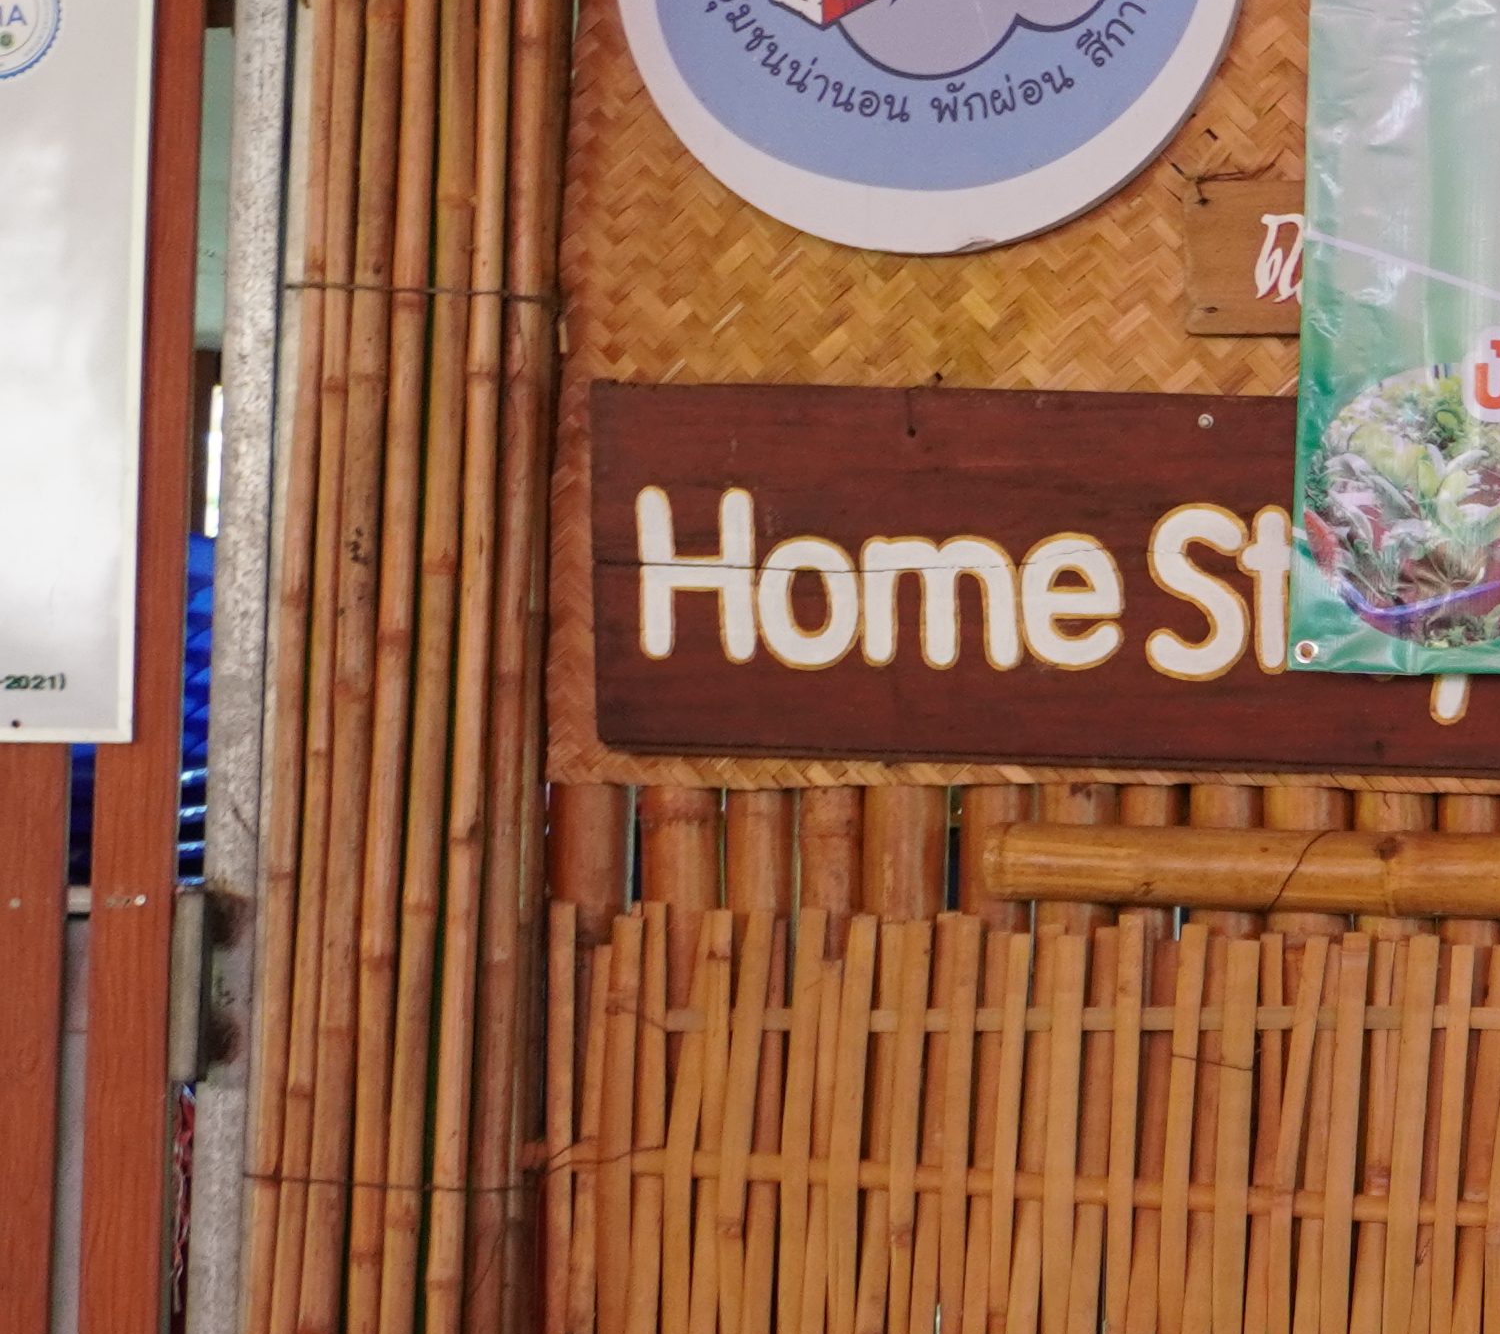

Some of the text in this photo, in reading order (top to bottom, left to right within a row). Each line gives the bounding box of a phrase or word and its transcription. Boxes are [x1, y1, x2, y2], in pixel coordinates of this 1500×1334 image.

[931, 65, 1075, 124] พักผ่อน
[635, 486, 1292, 682] Home St
